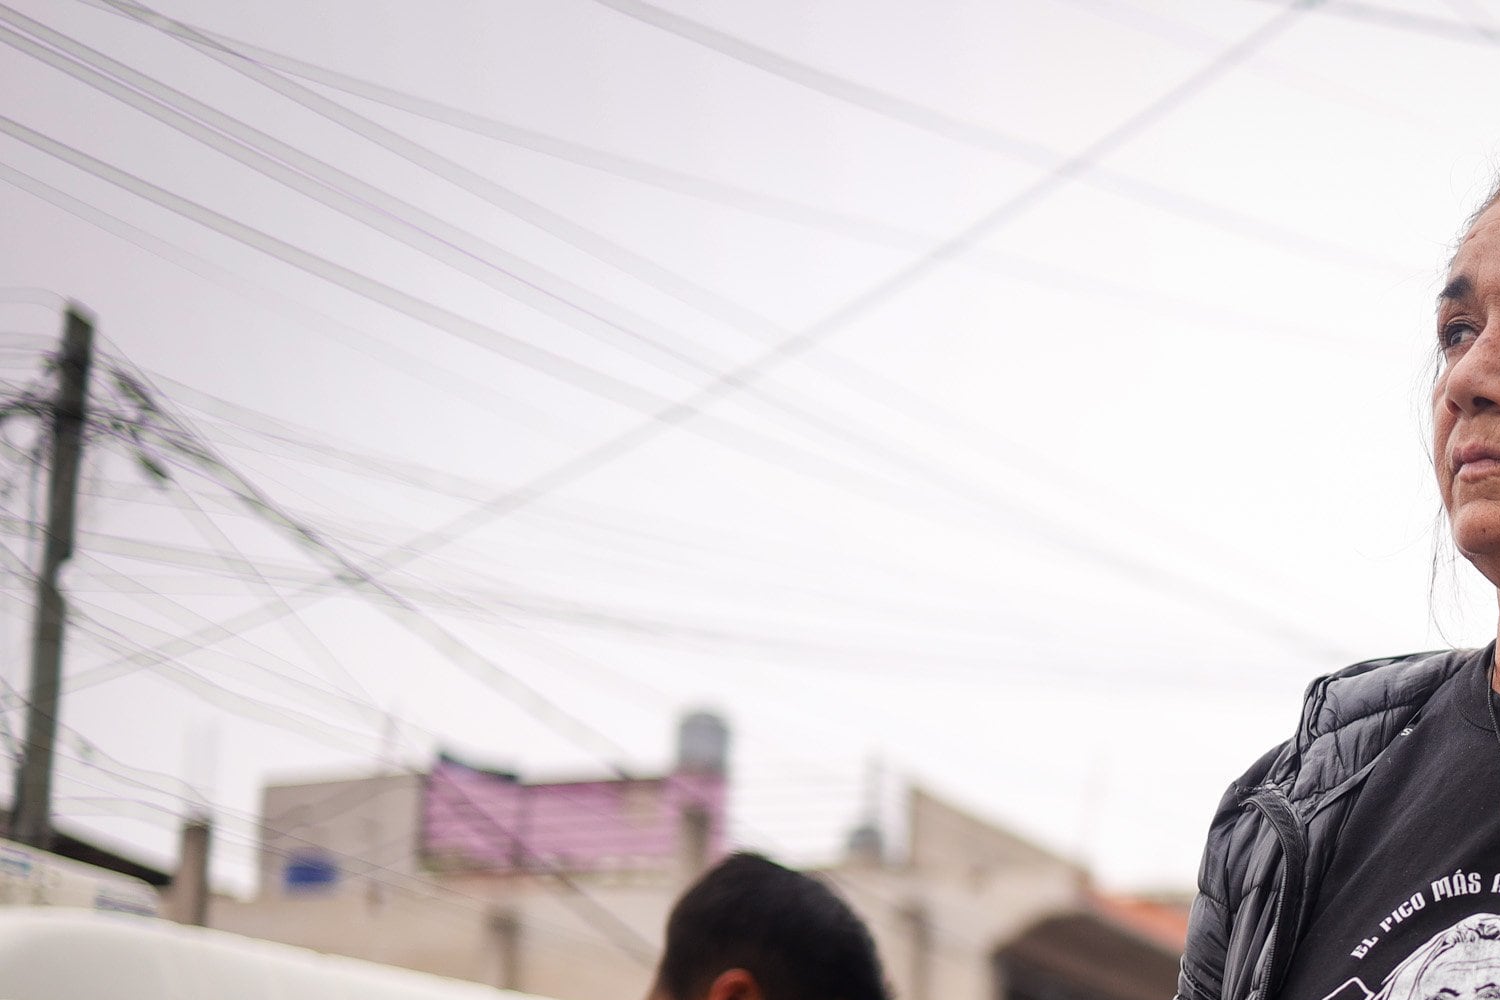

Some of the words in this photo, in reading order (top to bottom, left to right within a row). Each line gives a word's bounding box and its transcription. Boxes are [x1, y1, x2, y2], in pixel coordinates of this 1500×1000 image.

[1350, 936, 1379, 960] EL
[1379, 892, 1426, 933] PICO
[1430, 868, 1482, 902] MÁS
